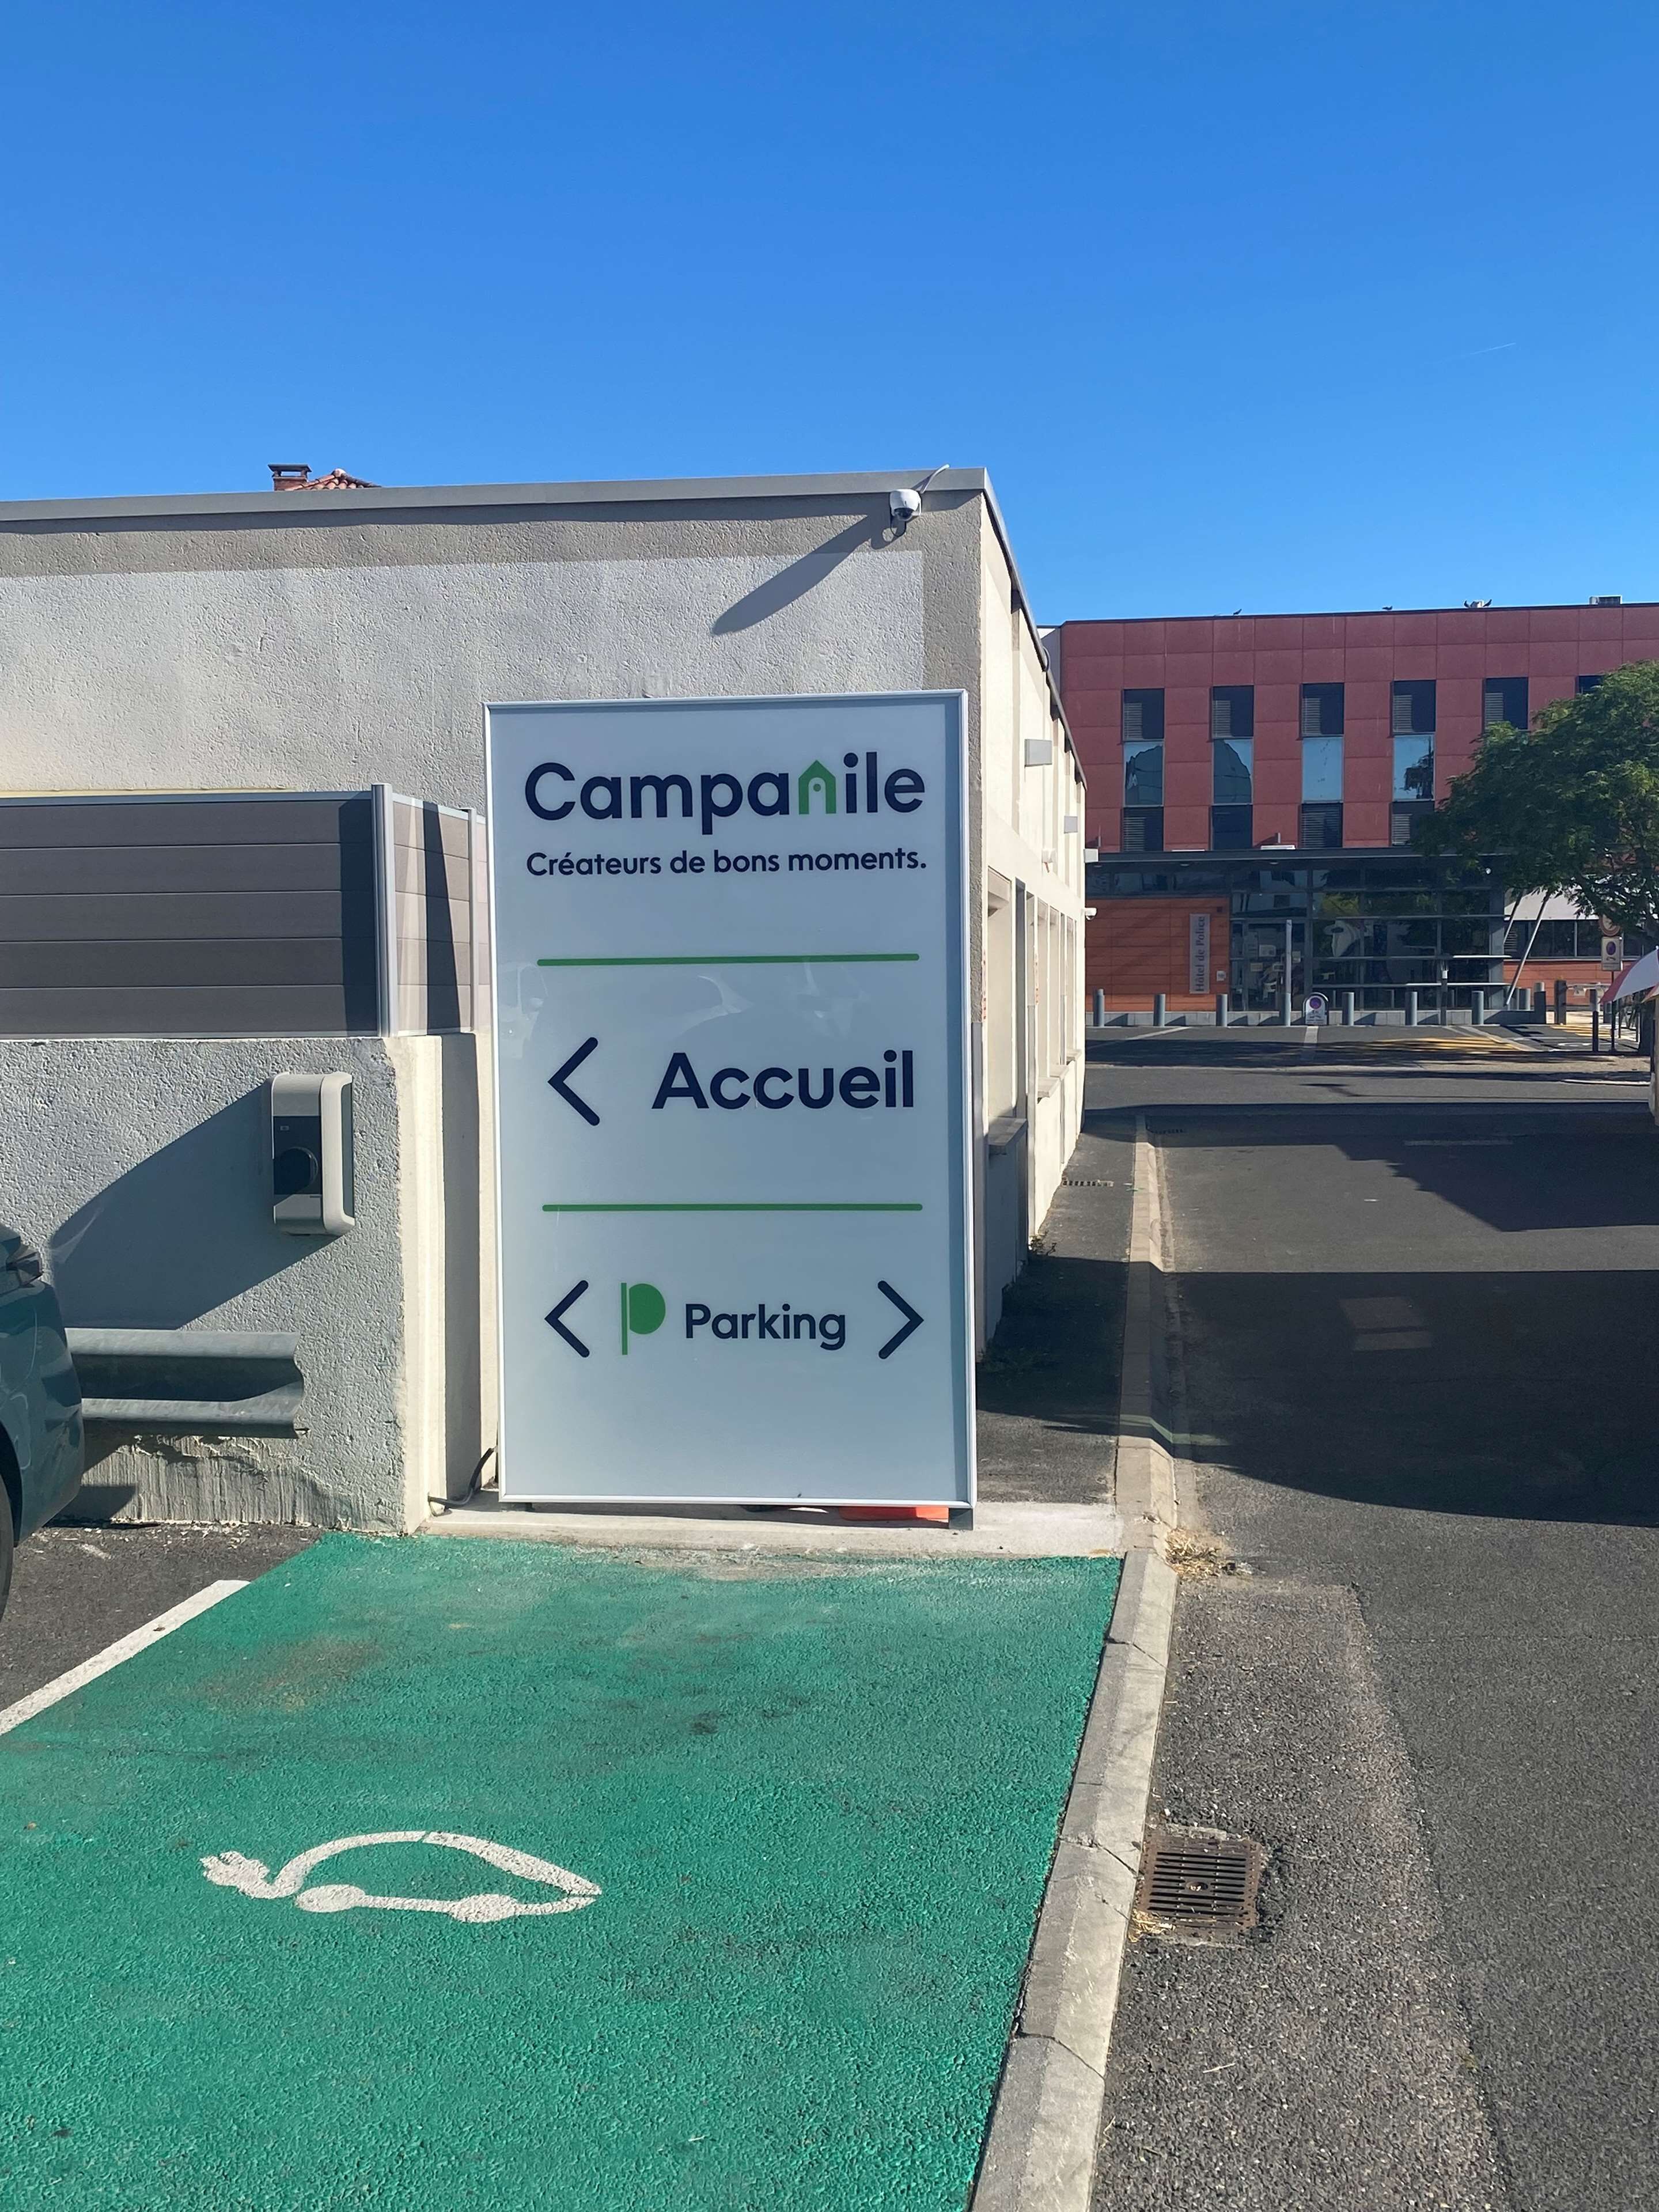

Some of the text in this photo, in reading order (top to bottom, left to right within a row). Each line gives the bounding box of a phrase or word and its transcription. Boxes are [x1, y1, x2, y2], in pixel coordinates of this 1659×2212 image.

[524, 751, 926, 836] Campanile
[527, 847, 927, 876] Créateurs de bons moments.
[1195, 916, 1205, 991] Hôtel de Police
[651, 1049, 914, 1110] Accueil
[685, 1303, 846, 1351] Parking
